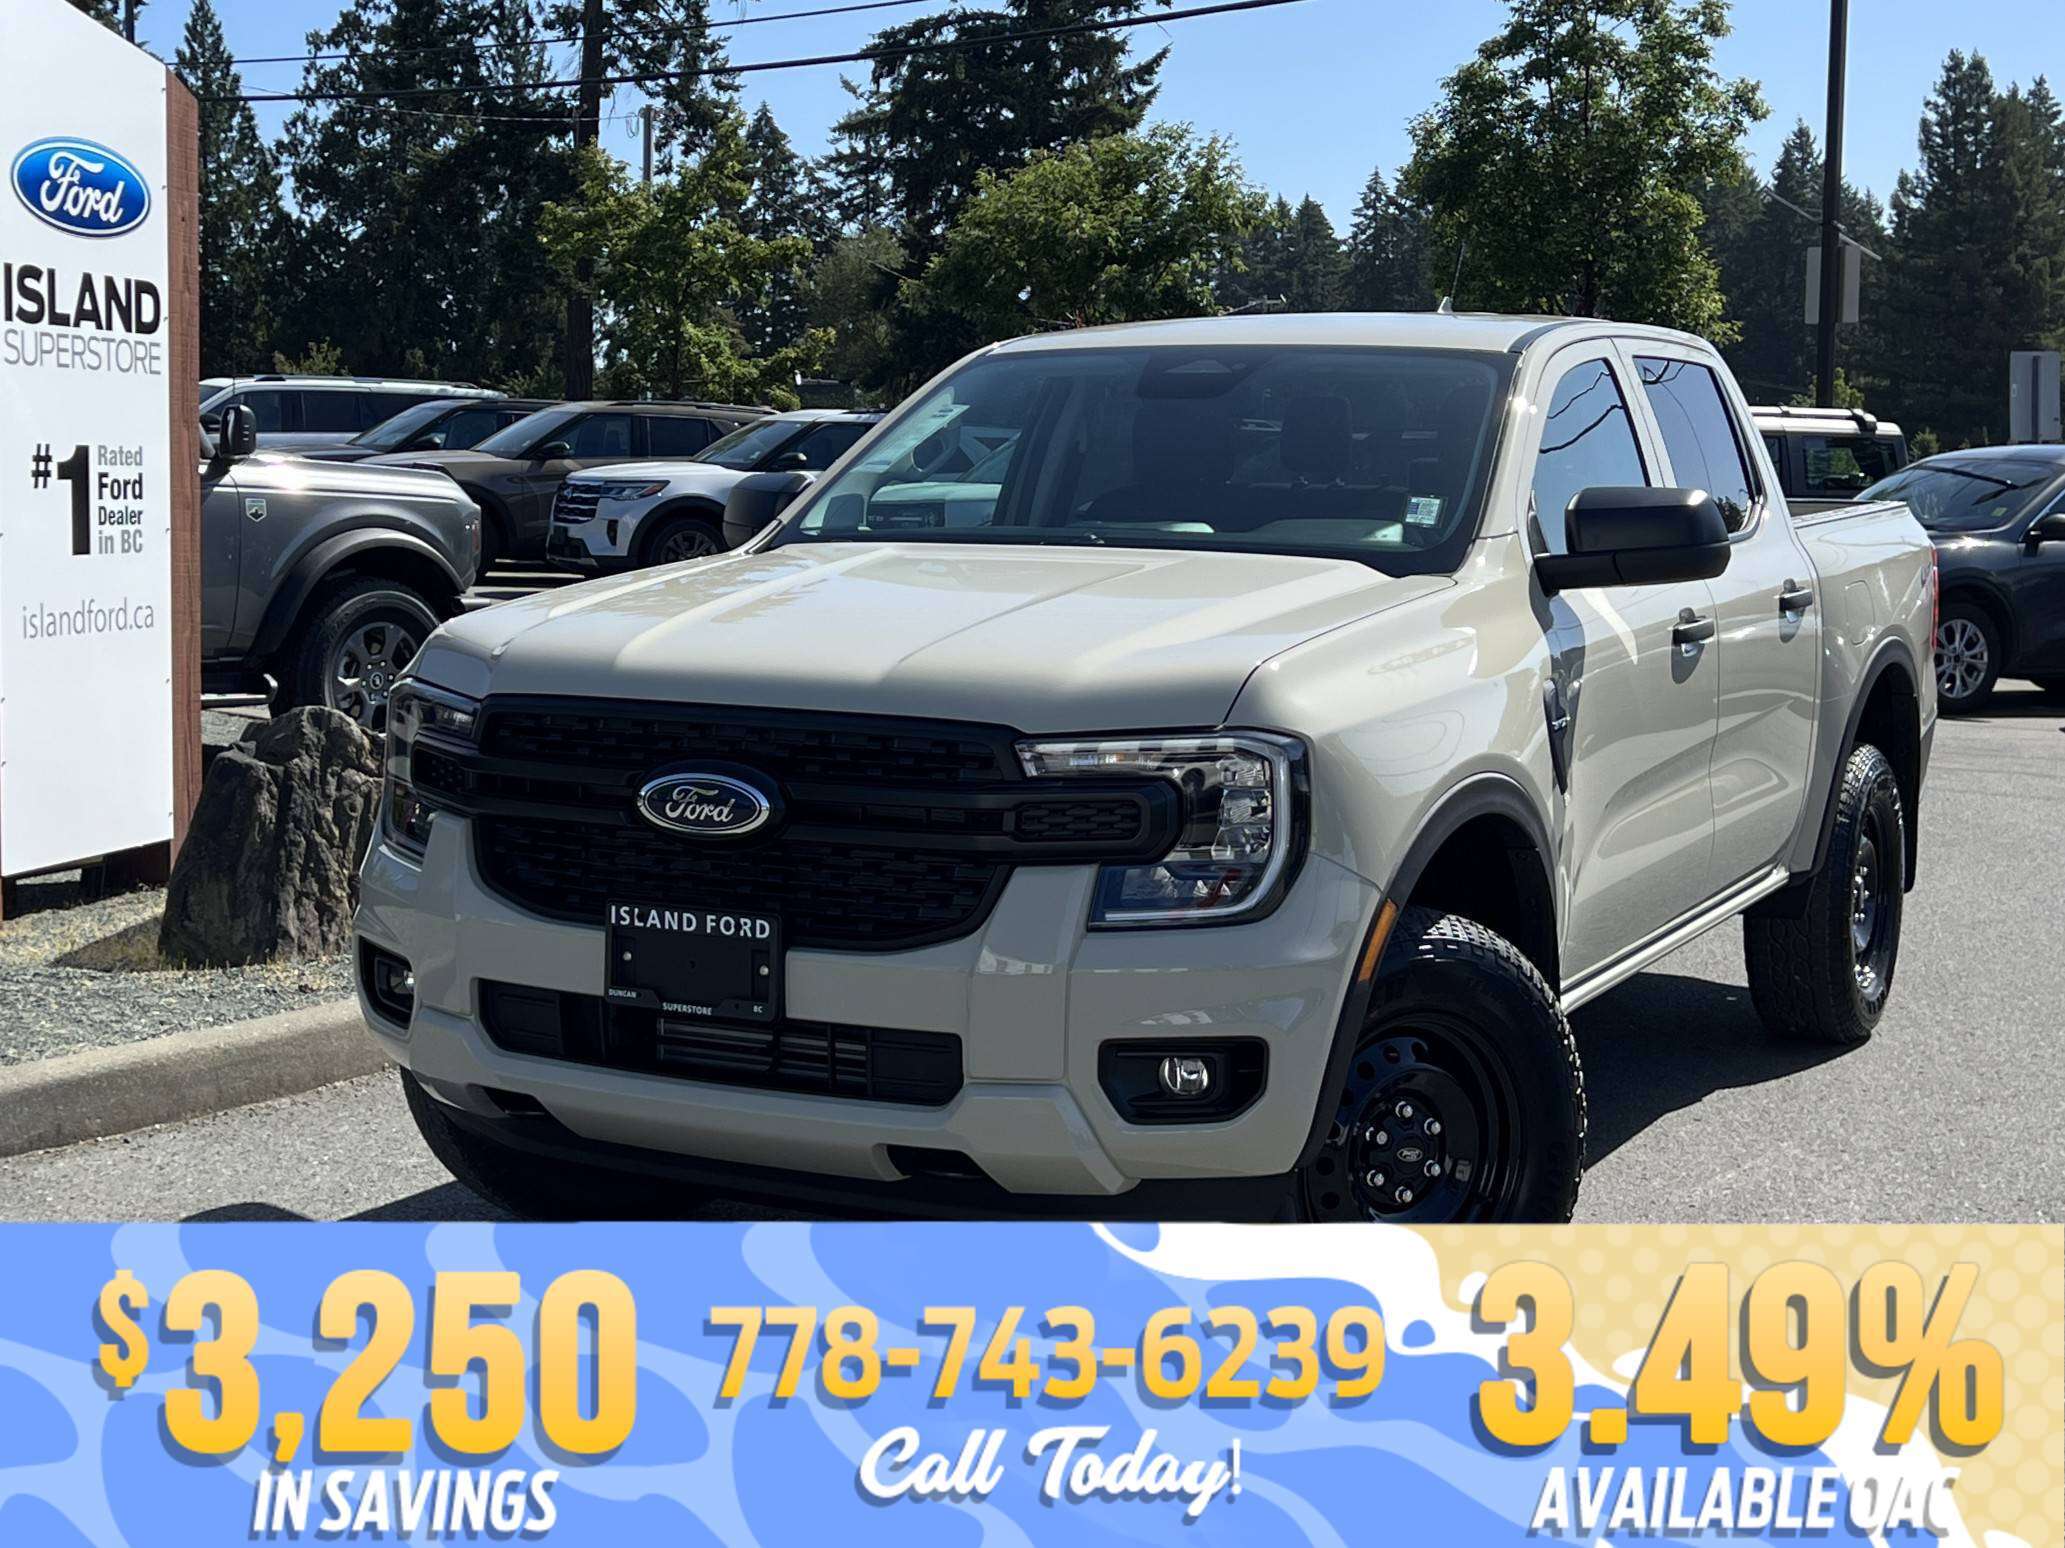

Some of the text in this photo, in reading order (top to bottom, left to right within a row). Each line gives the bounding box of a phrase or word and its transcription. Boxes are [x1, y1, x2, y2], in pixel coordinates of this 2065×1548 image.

[40, 151, 126, 223] Ford
[3, 262, 161, 335] ISLAND
[3, 328, 162, 375] SUPERSTORE
[98, 445, 143, 466] Rated
[31, 443, 91, 556] #1
[98, 472, 144, 500] Ford
[98, 505, 143, 526] Dealer
[98, 529, 143, 555] in BC
[22, 597, 155, 640] islandford.ca
[664, 785, 736, 823] Ford
[610, 905, 770, 939] ISLAND FORD
[608, 987, 637, 999] DUNCAN
[661, 1001, 712, 1016] SUPERSTORE
[753, 1004, 763, 1014] BC
